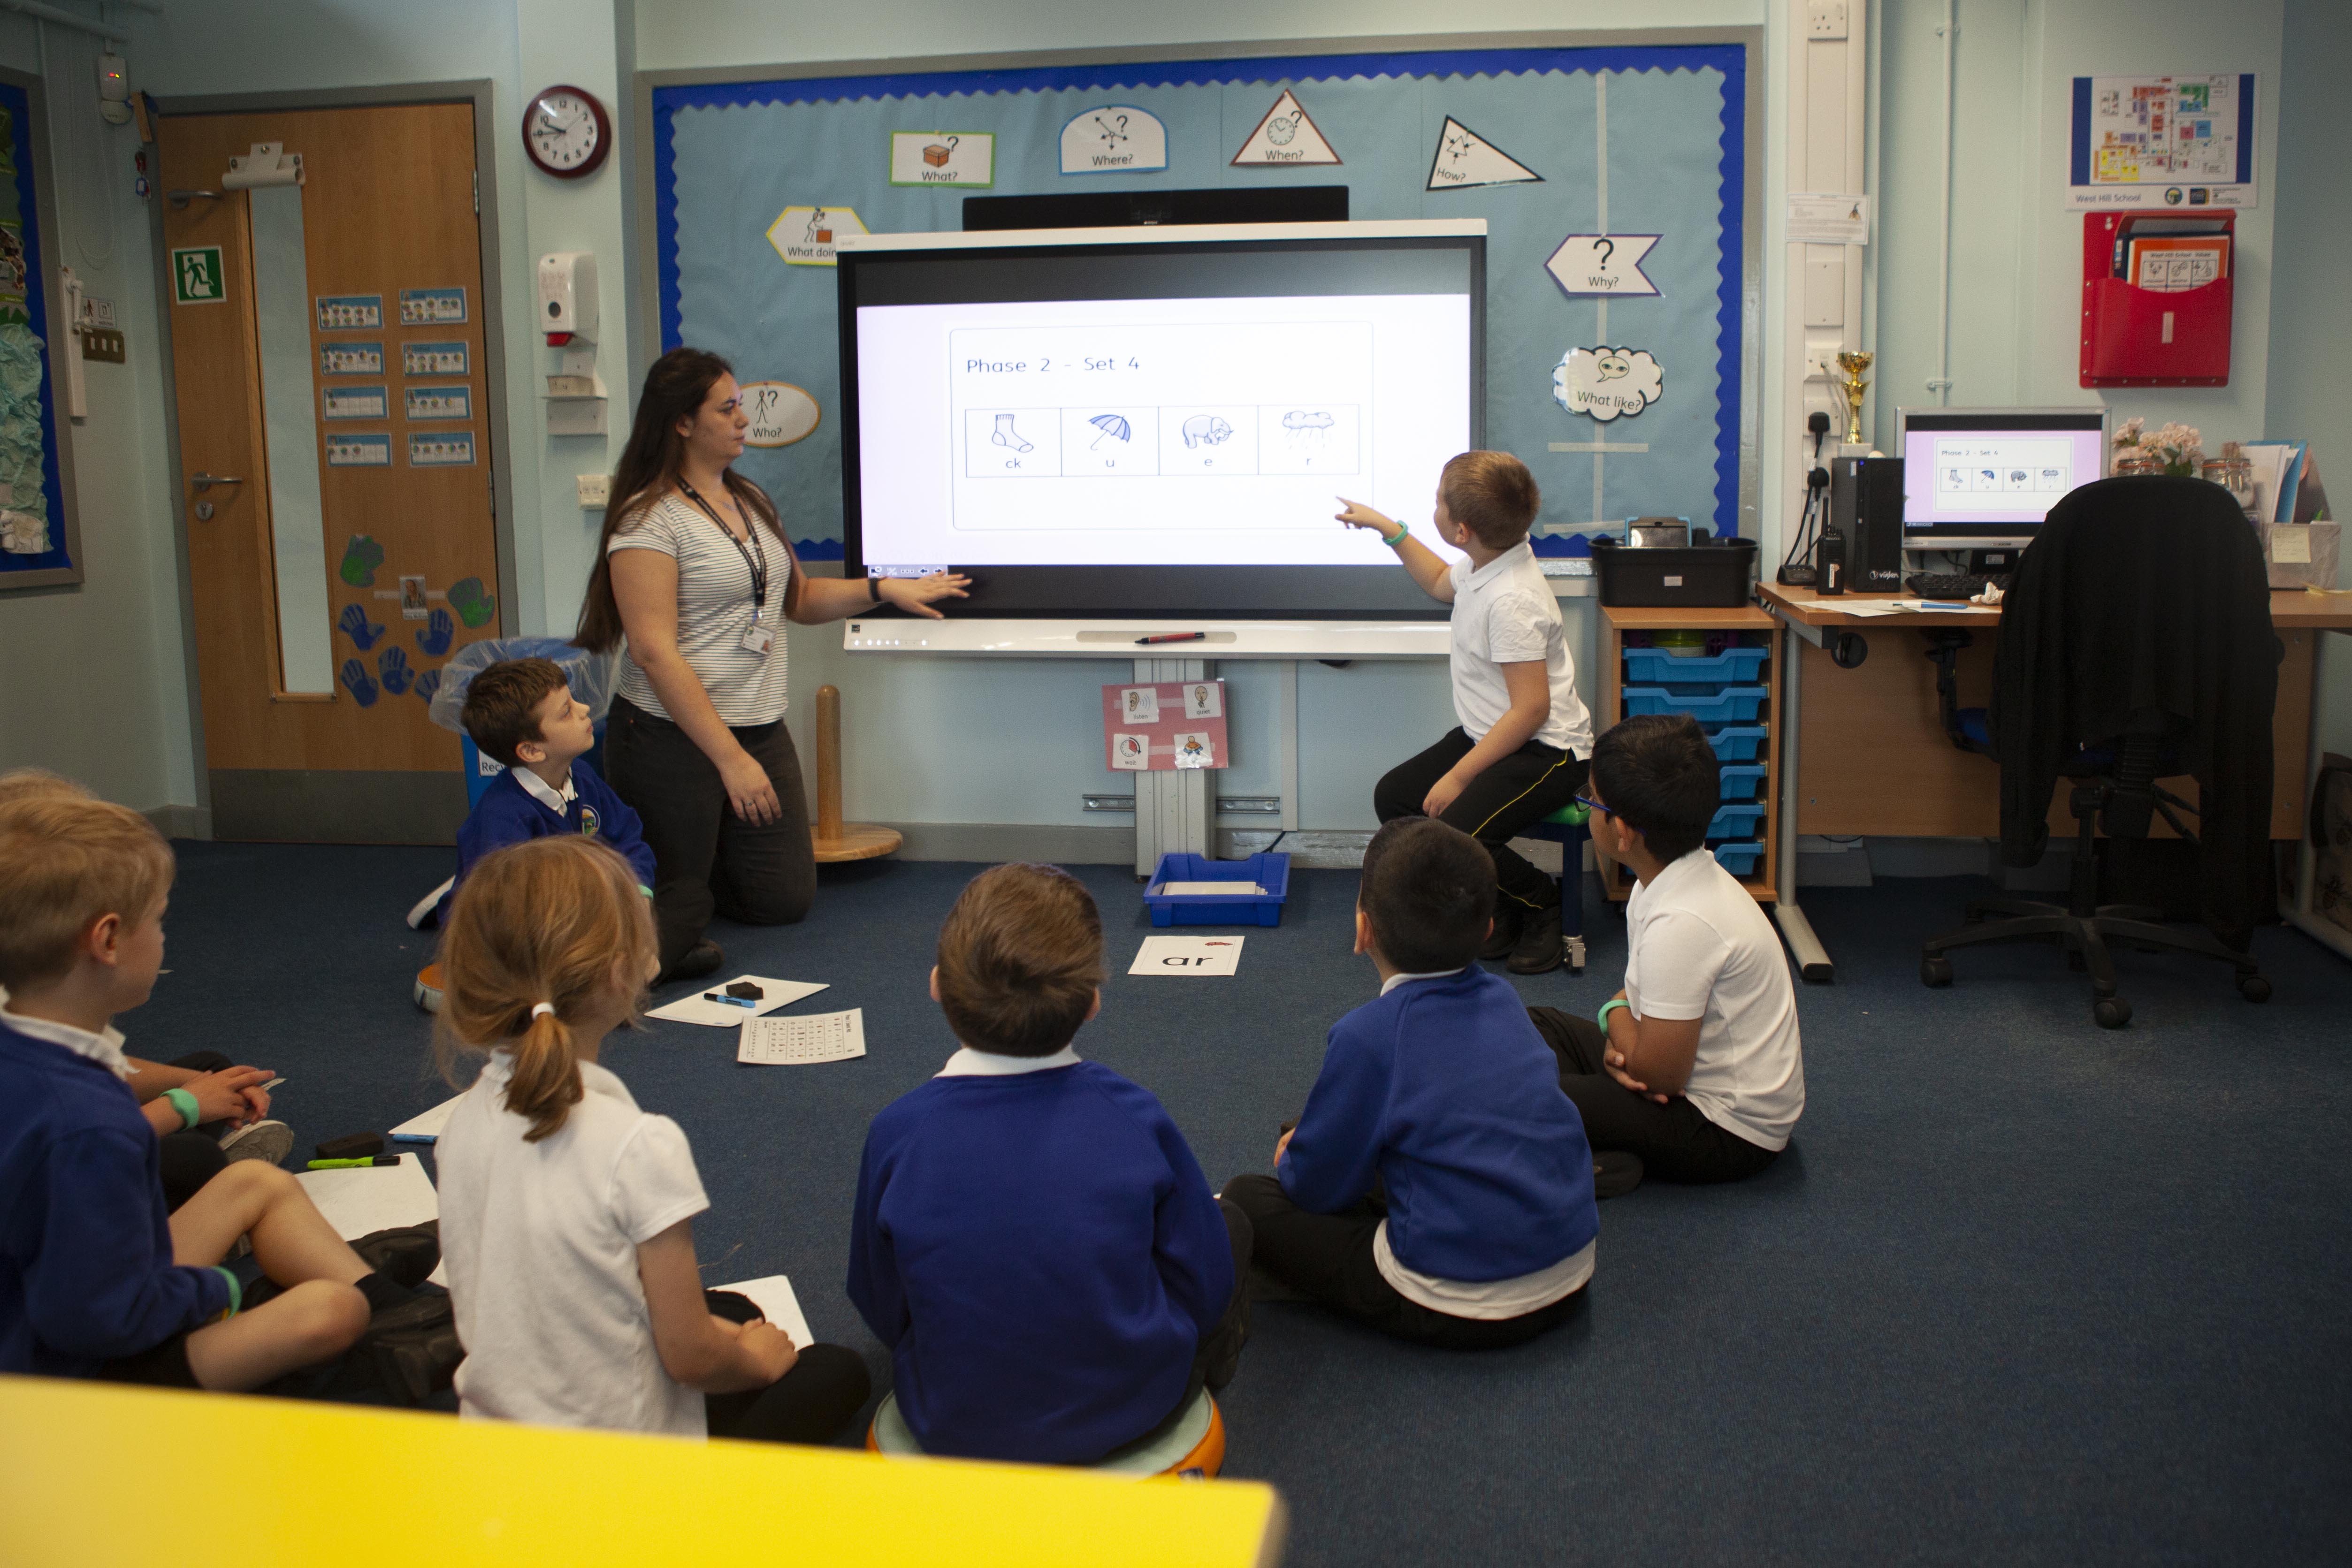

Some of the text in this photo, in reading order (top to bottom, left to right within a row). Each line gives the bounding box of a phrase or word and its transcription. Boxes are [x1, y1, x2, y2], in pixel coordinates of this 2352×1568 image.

[1092, 154, 1133, 166] Where?
[1266, 149, 1304, 160] When?
[922, 171, 958, 181] What?
[1436, 167, 1466, 182] How?
[787, 247, 814, 257] What
[1588, 276, 1619, 289] Why?
[967, 358, 1026, 373] Phase
[1040, 358, 1050, 372] 2
[1084, 357, 1115, 371] Set
[1128, 357, 1139, 370] 4
[1578, 391, 1641, 411] What like?
[753, 427, 781, 438] Who?
[1005, 457, 1022, 469] ck
[1106, 459, 1115, 467] u
[1204, 458, 1213, 467] e
[1306, 457, 1311, 467] r
[1879, 571, 1899, 580] viglen
[1162, 957, 1214, 966] ar
